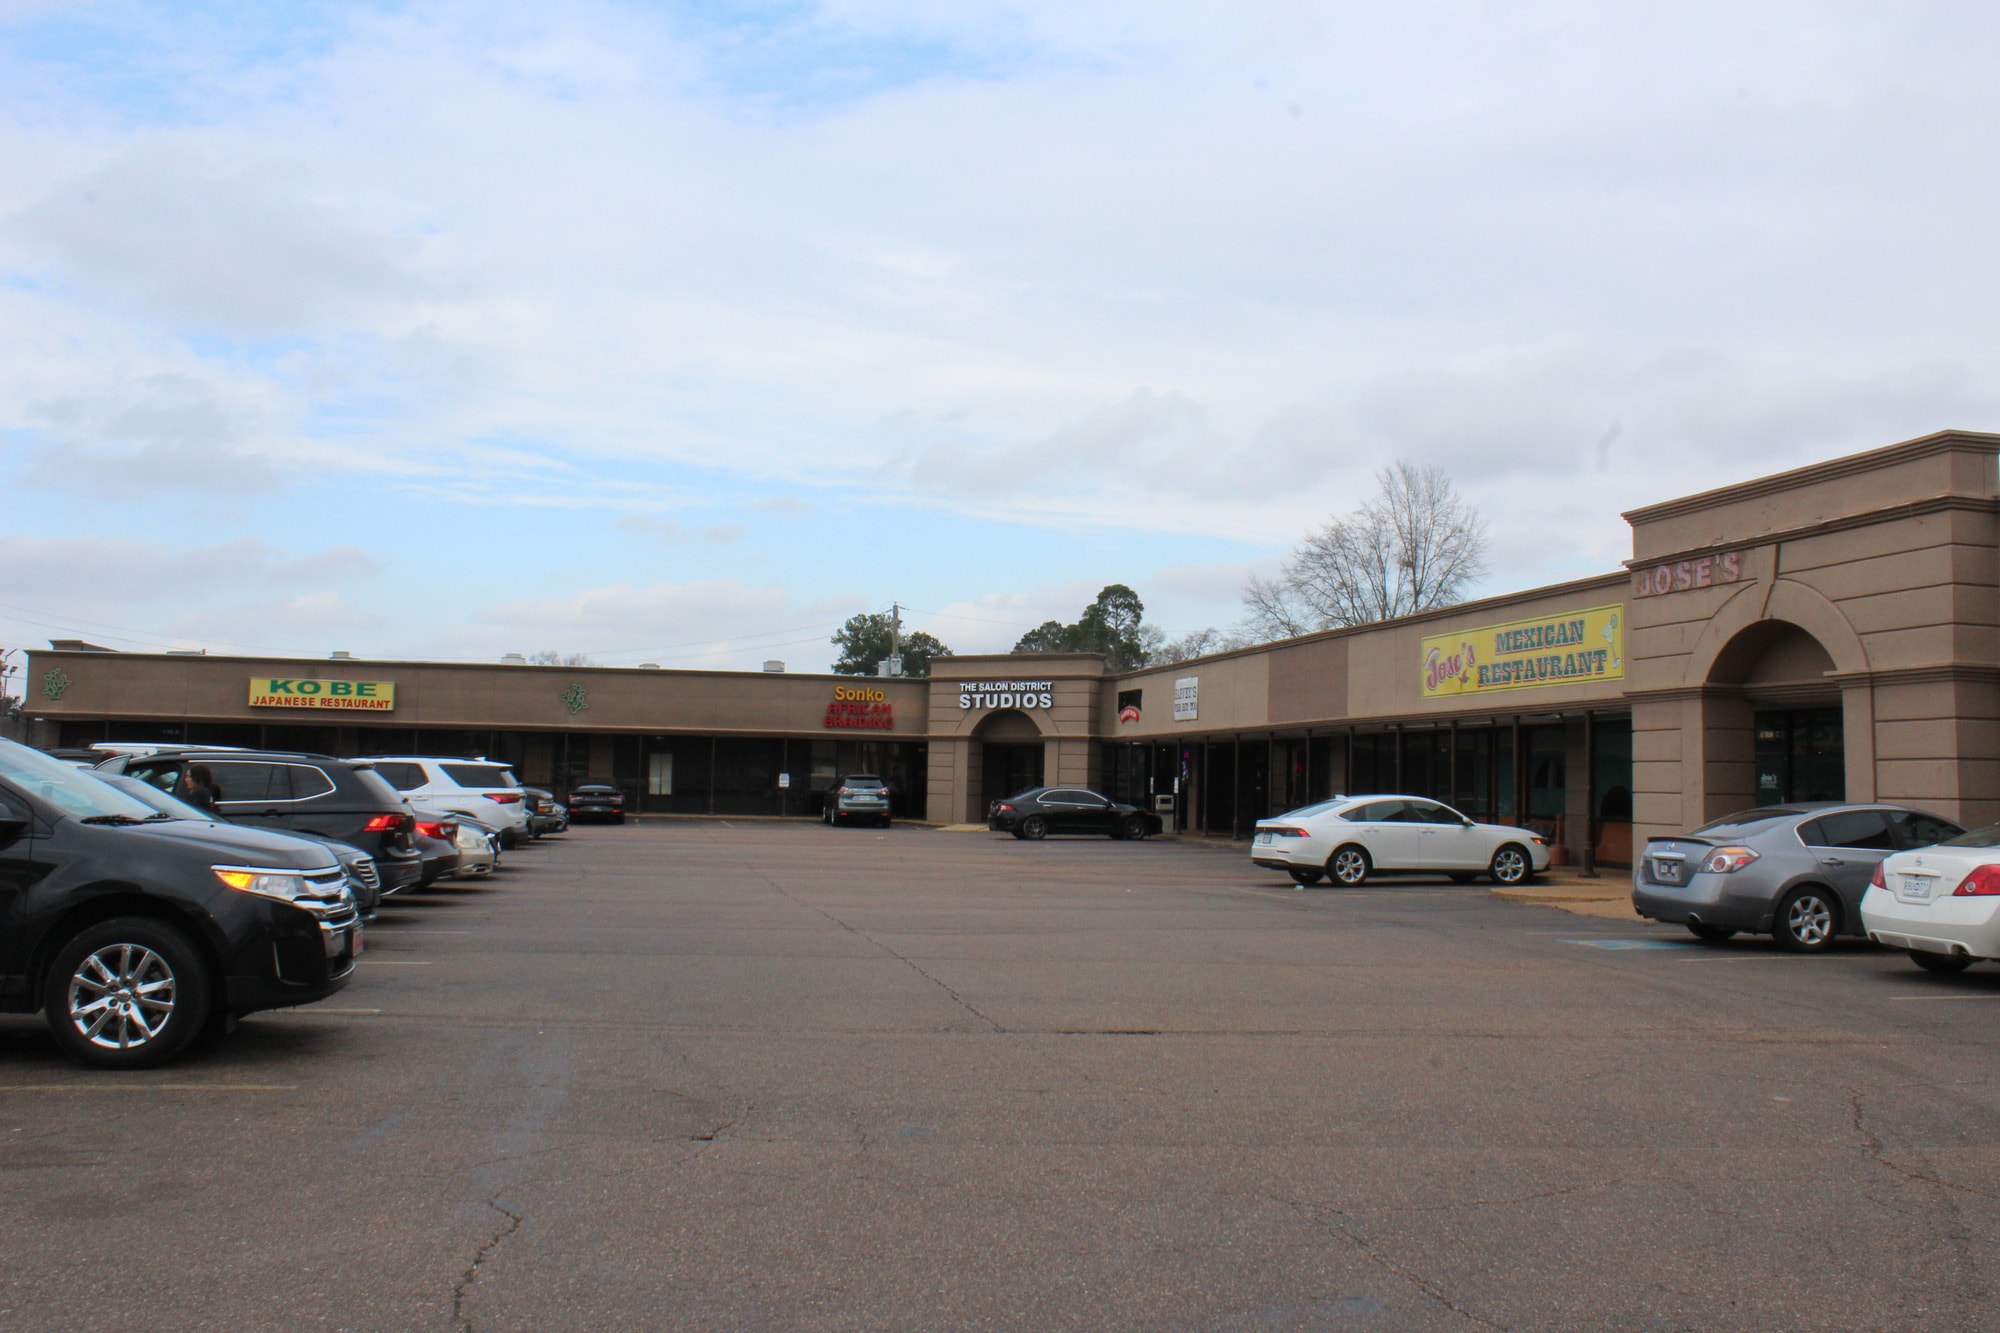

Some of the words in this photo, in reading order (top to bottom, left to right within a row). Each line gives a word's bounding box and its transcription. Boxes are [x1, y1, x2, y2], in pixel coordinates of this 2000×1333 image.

[1640, 552, 1740, 596] JOSE'S
[1495, 619, 1585, 655] MEXICAN
[1426, 642, 1476, 690] Jose's
[1477, 649, 1607, 688] RESTAURANT
[834, 685, 885, 702] Sonko
[960, 683, 977, 692] THE
[979, 682, 1009, 692] SALON
[1011, 681, 1053, 691] DISTRICT
[253, 696, 316, 707] JAPANESE
[320, 698, 391, 709] RESTAURANT
[827, 701, 893, 715] AFRICAN
[959, 692, 1053, 709] STUDIOS
[824, 714, 894, 730] BRAIDING
